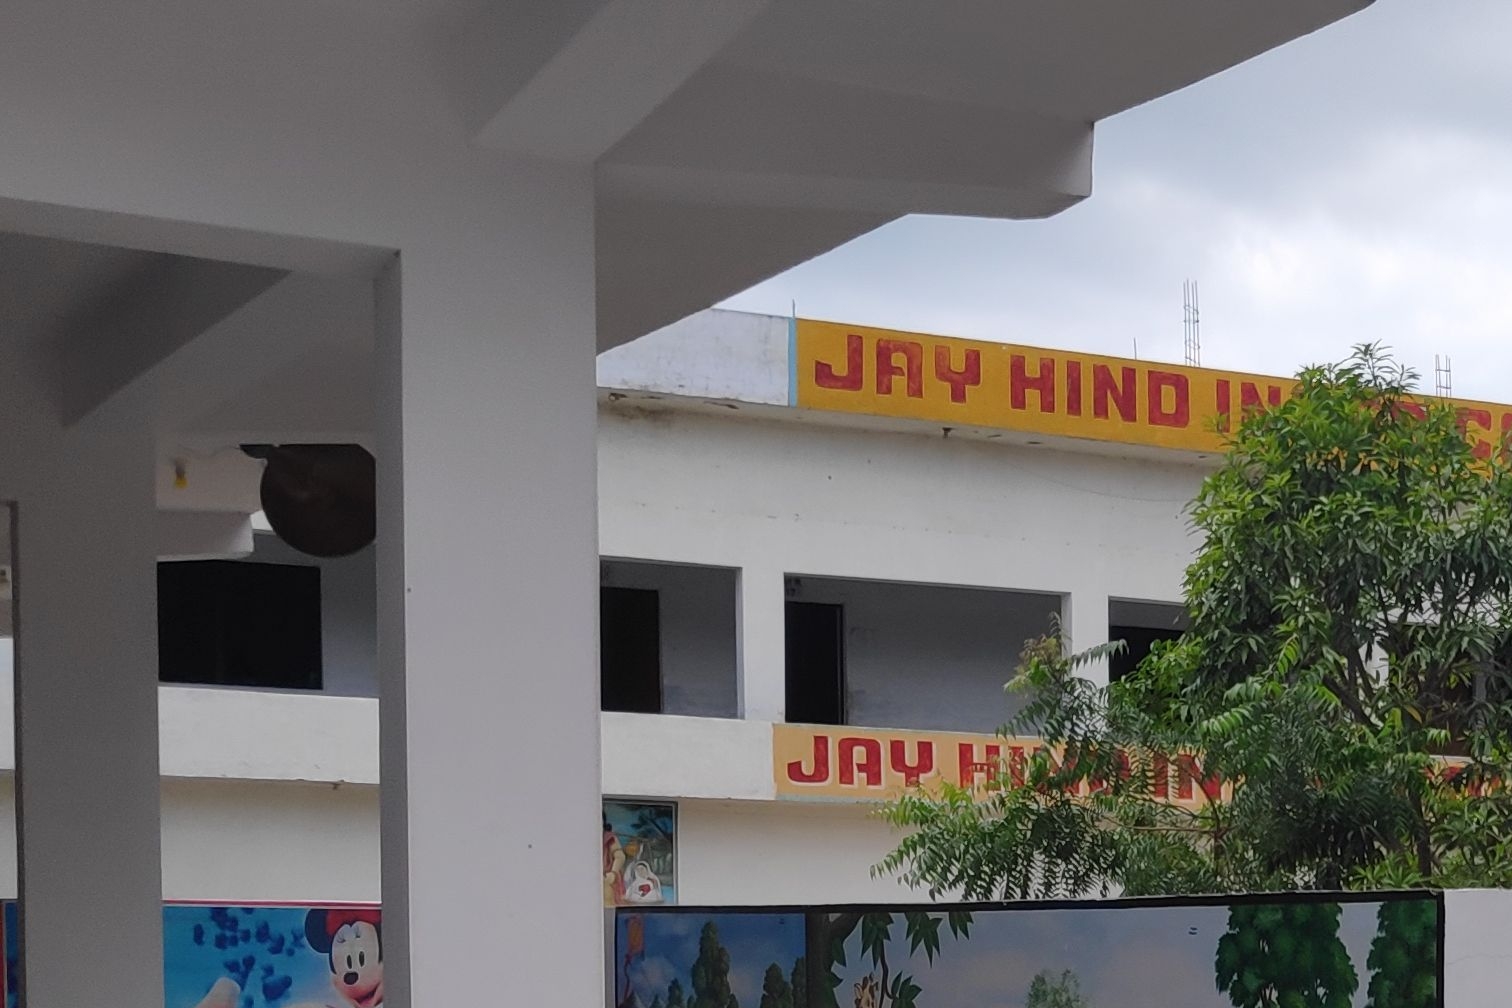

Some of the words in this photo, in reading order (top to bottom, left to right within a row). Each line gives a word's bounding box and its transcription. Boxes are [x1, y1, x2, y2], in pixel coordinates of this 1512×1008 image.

[815, 334, 981, 404] JAY
[1010, 355, 1190, 428] HIND
[787, 735, 934, 788] JAY
